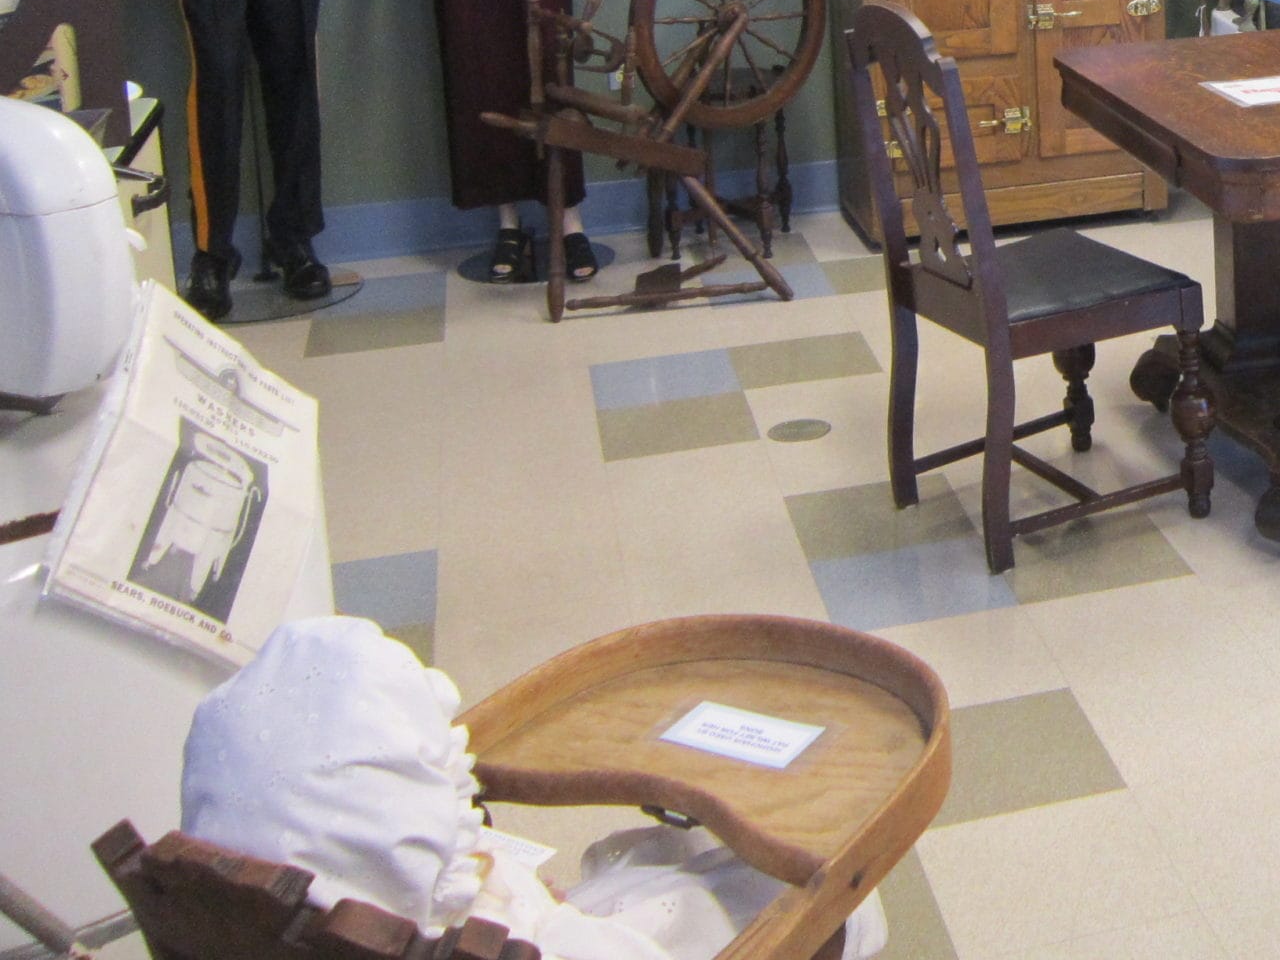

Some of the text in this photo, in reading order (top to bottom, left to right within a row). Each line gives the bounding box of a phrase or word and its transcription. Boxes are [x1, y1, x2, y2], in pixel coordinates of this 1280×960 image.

[197, 393, 256, 437] WASHERS
[111, 580, 146, 603] SEARS,
[150, 596, 196, 624] ROEBUCK
[198, 617, 218, 635] AND
